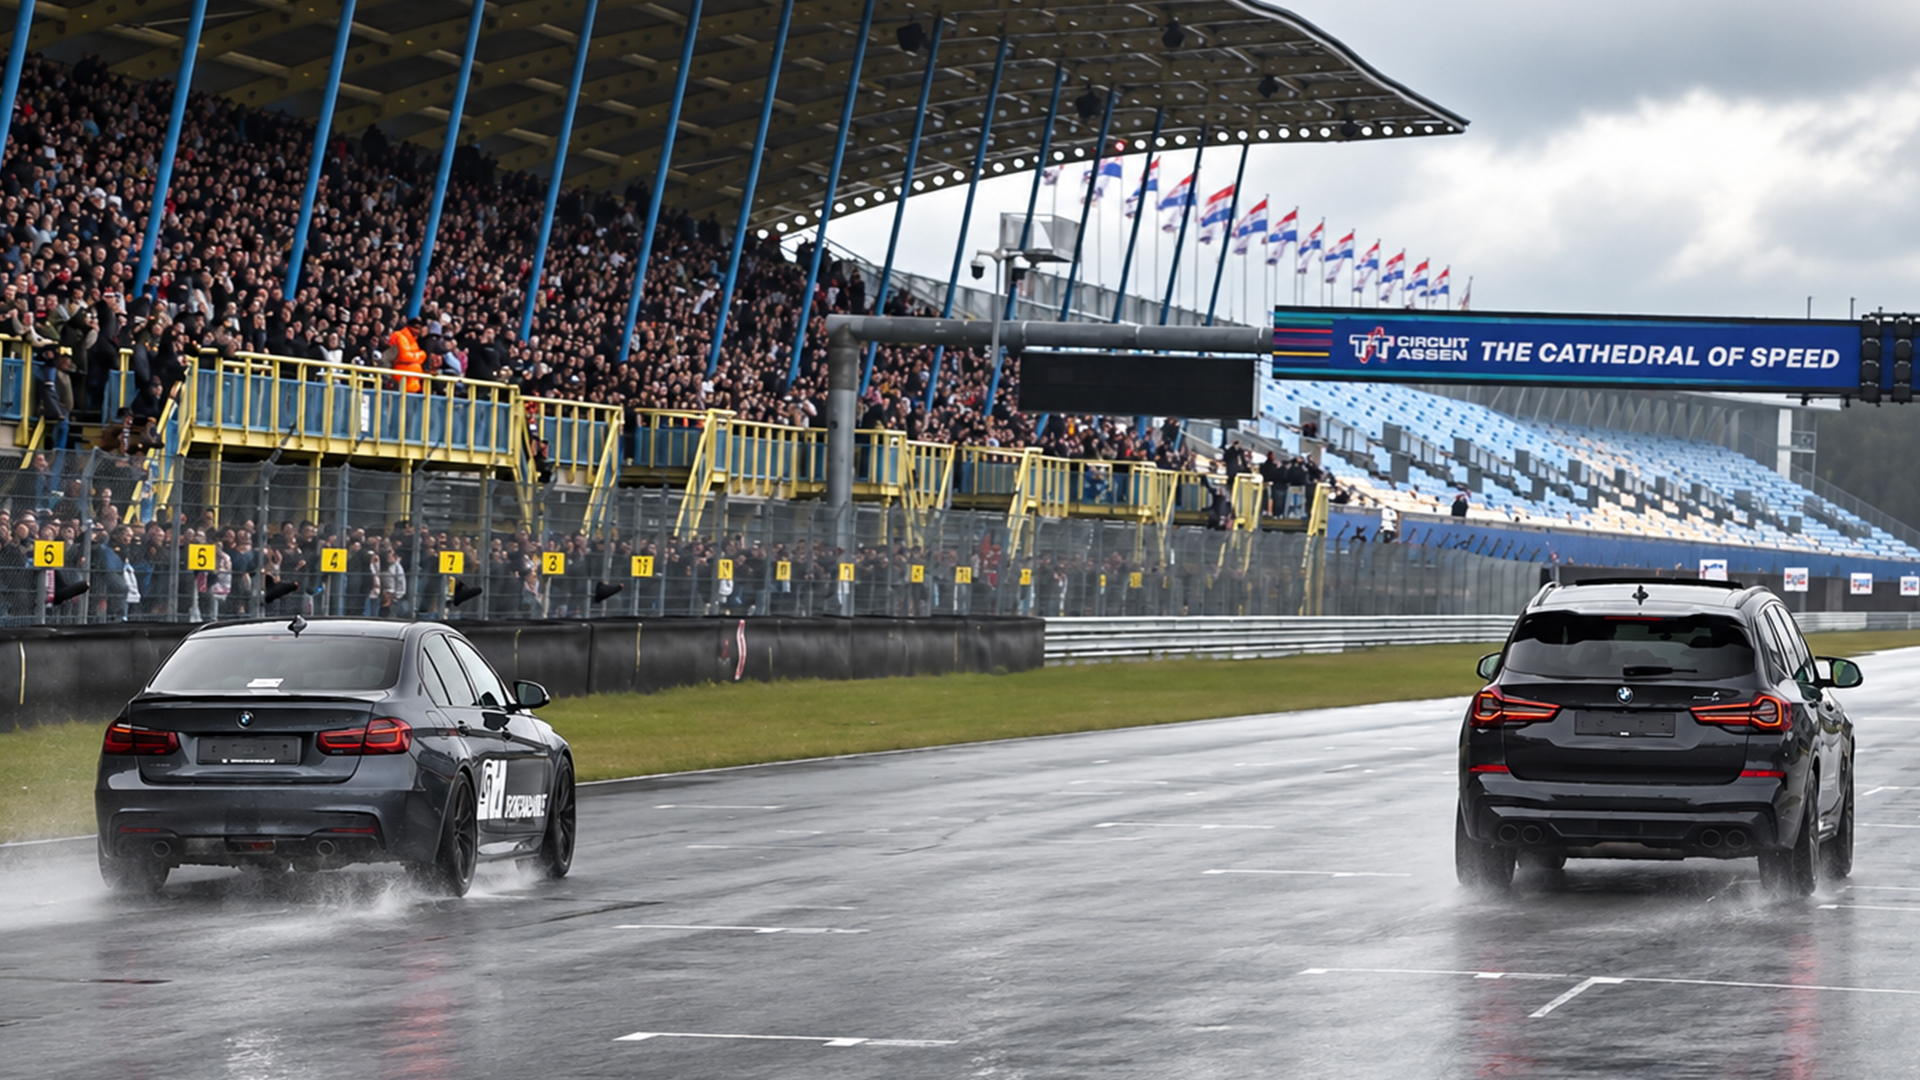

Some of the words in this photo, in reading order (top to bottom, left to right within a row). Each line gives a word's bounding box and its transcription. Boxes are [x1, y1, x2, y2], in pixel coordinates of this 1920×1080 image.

[1396, 335, 1470, 349] CIRCUIT
[1396, 348, 1468, 361] ASSEN
[1481, 341, 1534, 362] THE
[1538, 342, 1700, 366] CATHEDRAL
[1707, 346, 1746, 367] OF
[1750, 347, 1841, 369] SPEED
[44, 543, 55, 565] 6
[197, 547, 207, 567] 5
